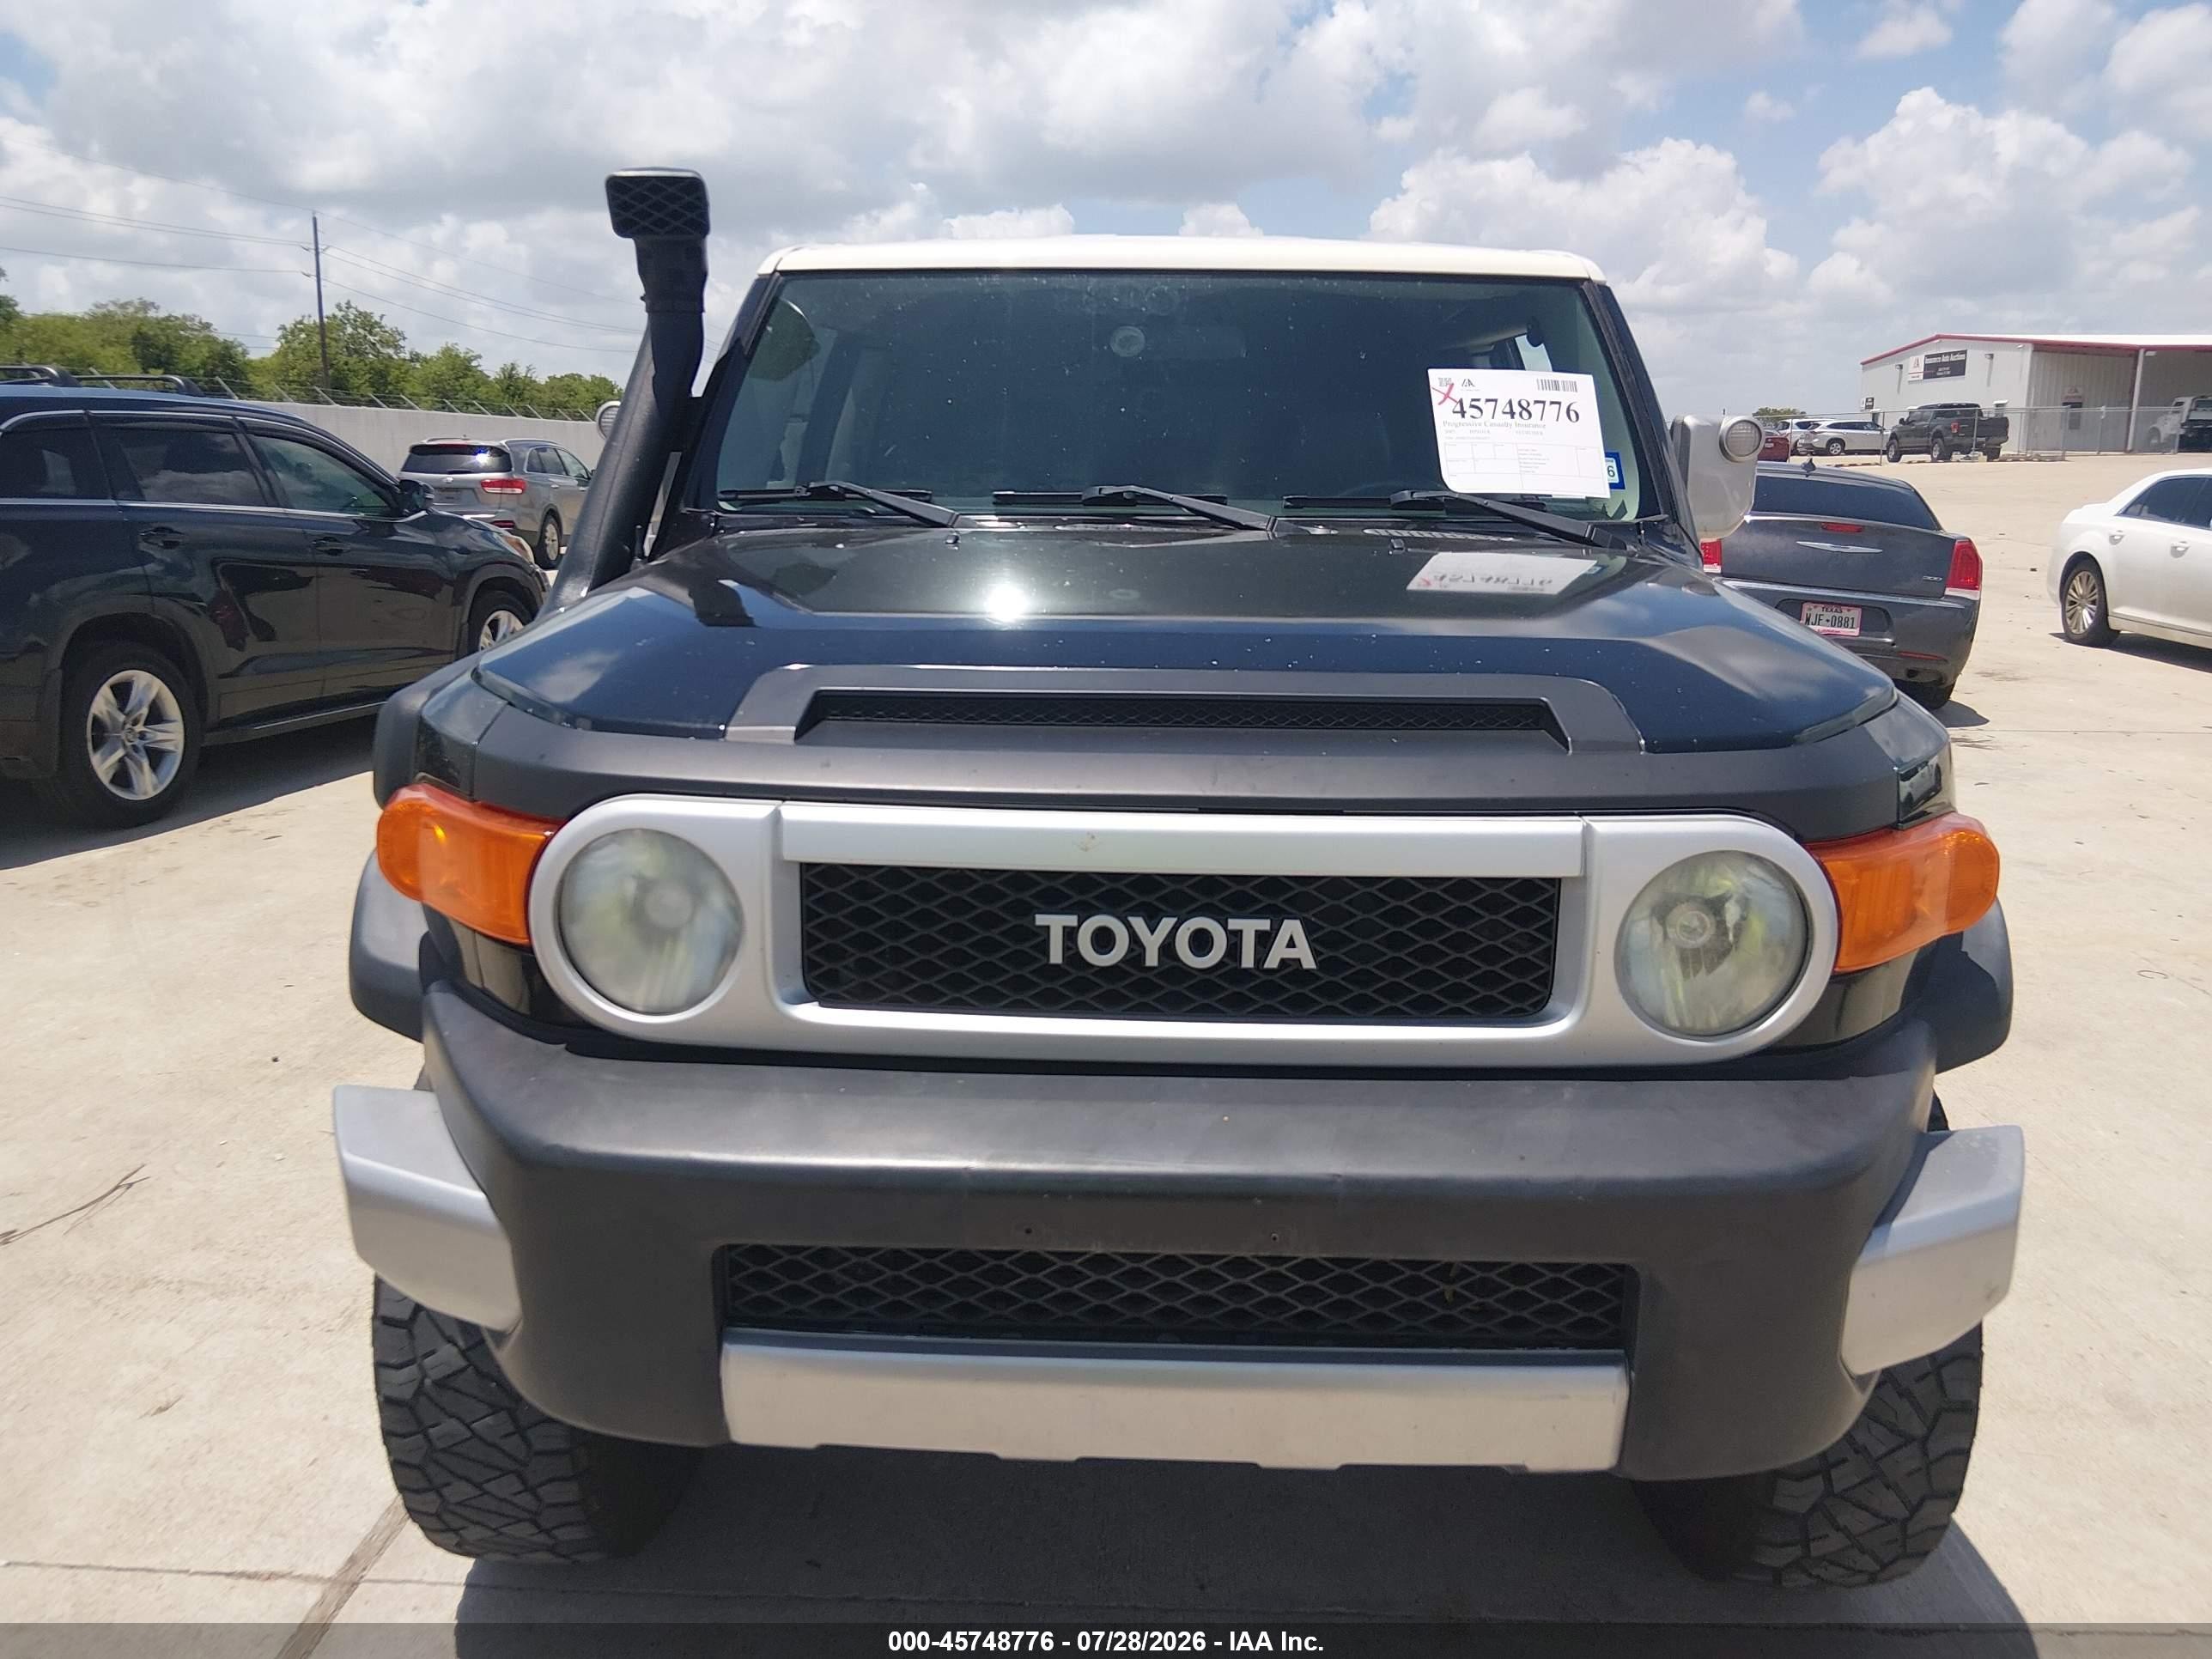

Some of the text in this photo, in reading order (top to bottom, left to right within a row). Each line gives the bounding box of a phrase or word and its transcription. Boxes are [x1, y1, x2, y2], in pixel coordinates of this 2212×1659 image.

[1452, 398, 1580, 423] 45748776
[1443, 420, 1482, 428] Progressive
[1483, 421, 1513, 429] Casualty
[1607, 465, 1616, 477] 6
[1821, 605, 1843, 614] TEXAS
[1035, 915, 1317, 969] TOYOTA
